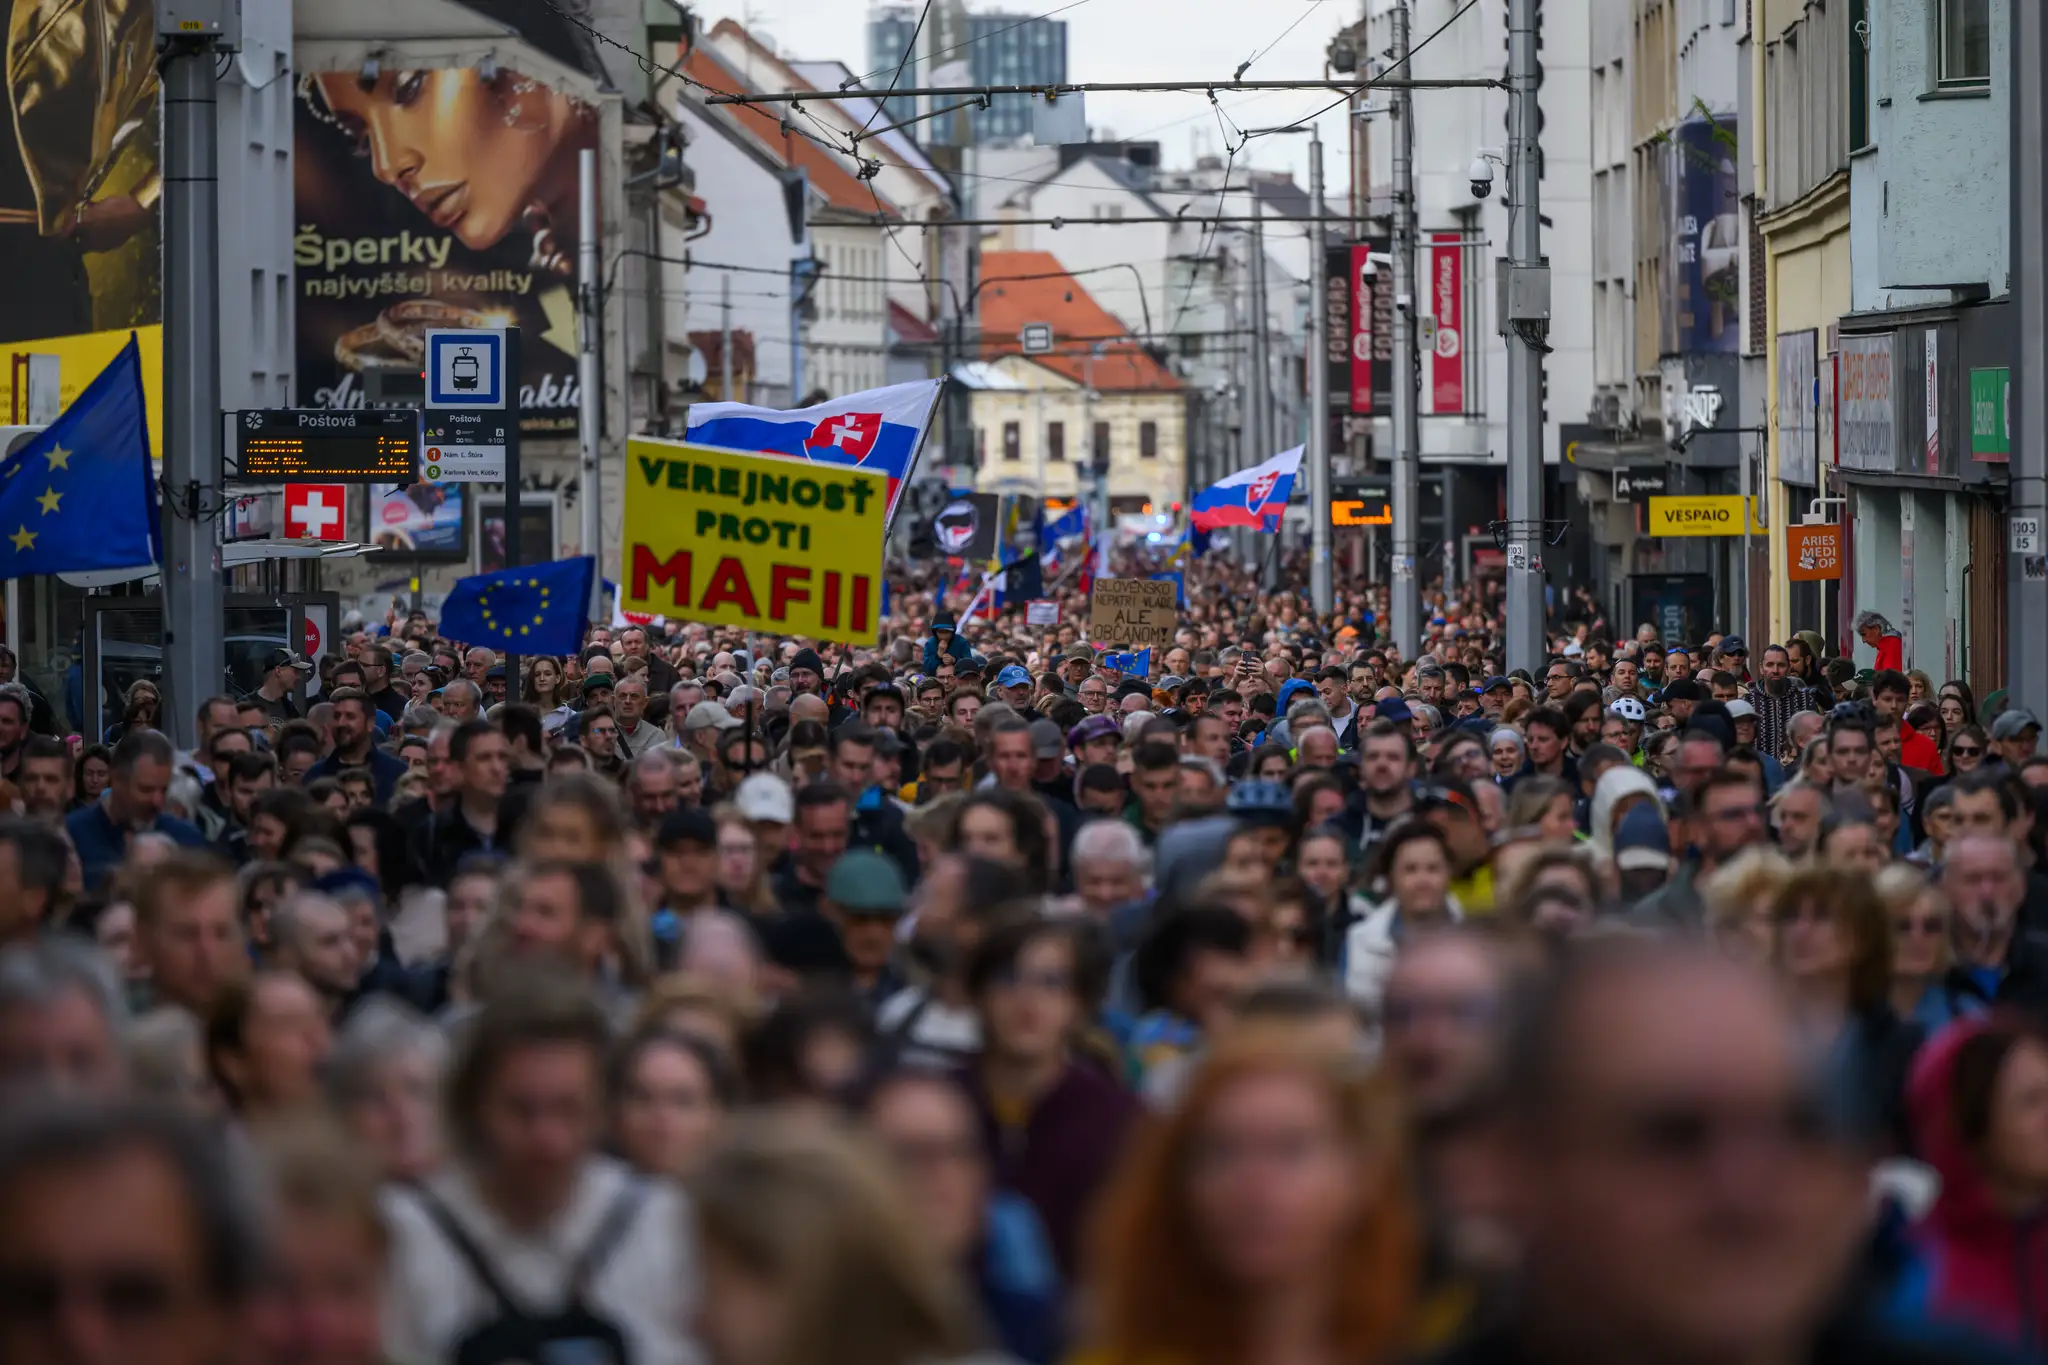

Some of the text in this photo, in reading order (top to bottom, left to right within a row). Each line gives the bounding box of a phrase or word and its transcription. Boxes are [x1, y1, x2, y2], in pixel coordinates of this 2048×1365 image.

[293, 224, 452, 271] Šperky
[305, 270, 533, 299] najvyššej kvality
[299, 414, 356, 427] Poštová
[449, 415, 481, 423] Poštová
[431, 450, 437, 459] 1
[430, 467, 437, 477] 9
[638, 455, 875, 517] VEREJNOSŤ
[1664, 509, 1730, 523] VESPAIO
[696, 509, 811, 552] PROTI
[1801, 535, 1836, 547] ARIES
[1801, 547, 1836, 558] MEDI
[631, 542, 870, 634] MAFII
[1096, 580, 1171, 595] SLOVENSKO
[1114, 609, 1152, 625] ALE
